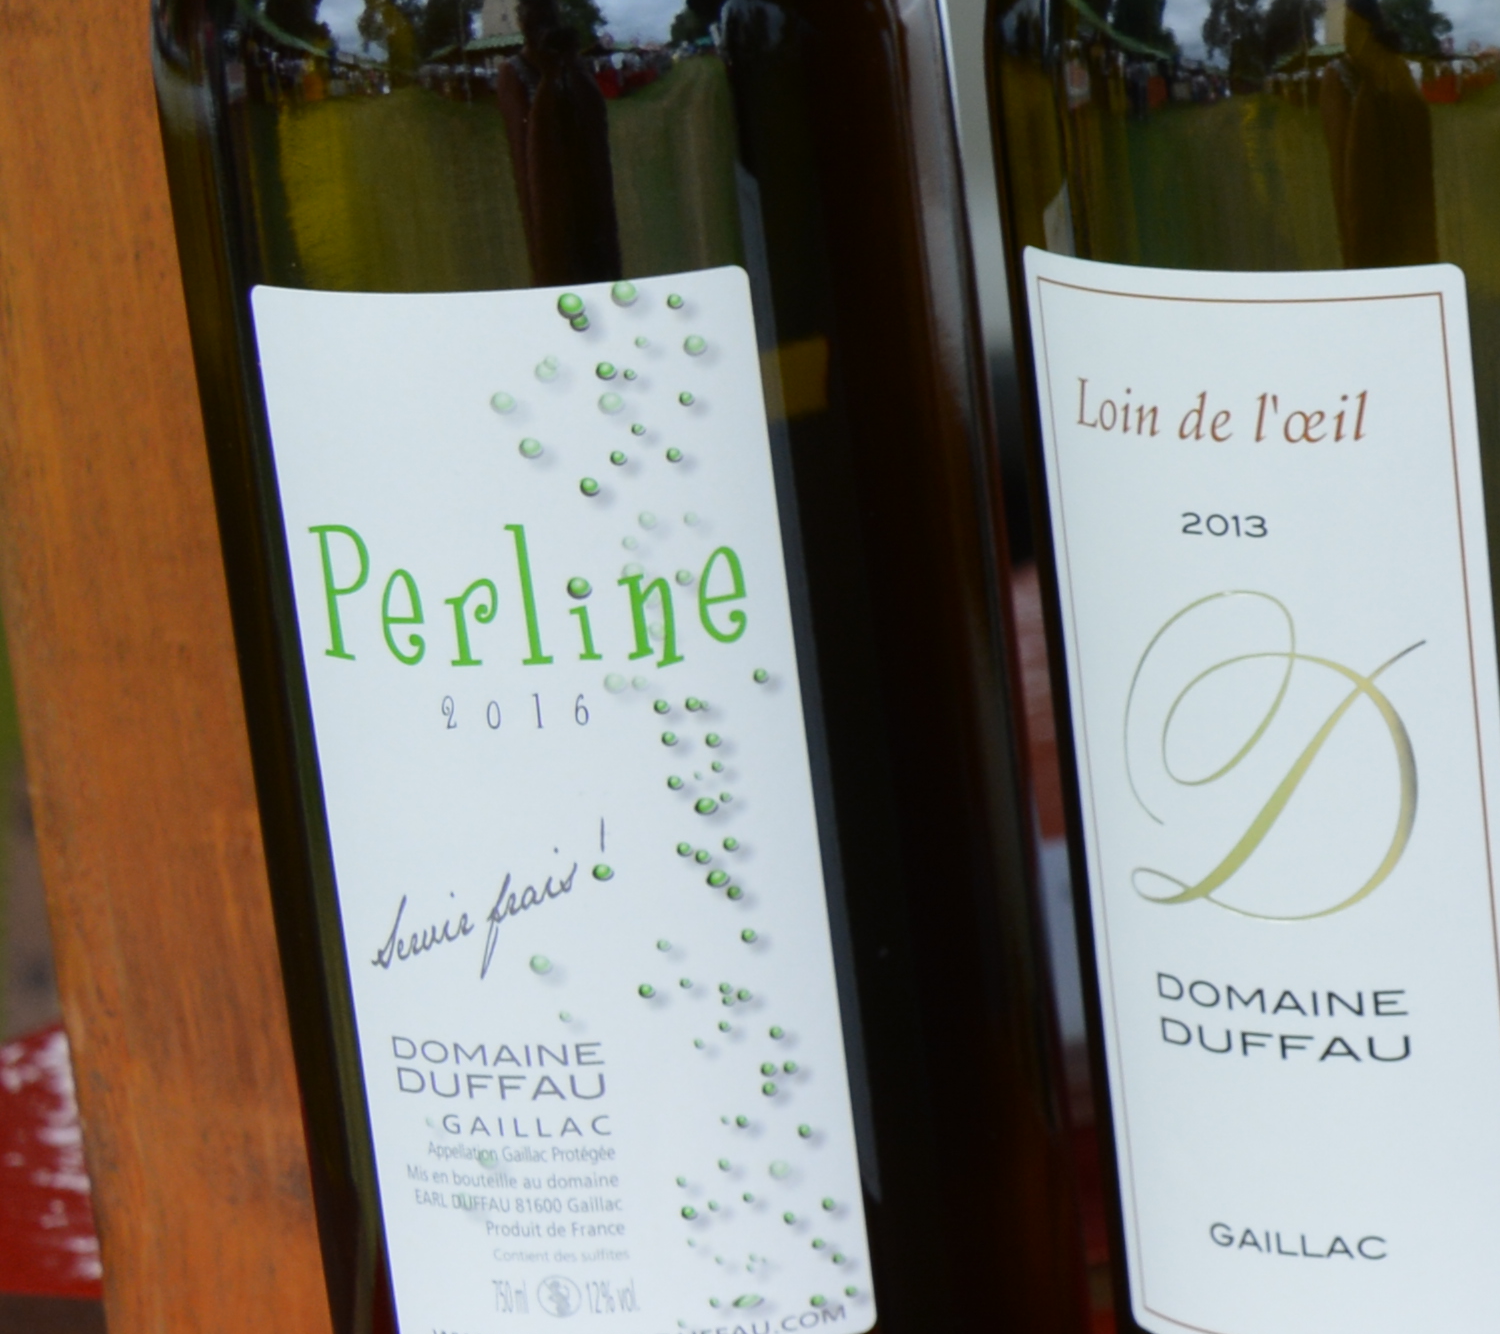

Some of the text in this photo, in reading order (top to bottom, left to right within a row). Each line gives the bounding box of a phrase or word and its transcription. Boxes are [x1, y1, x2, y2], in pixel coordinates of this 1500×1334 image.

[1076, 377, 1160, 437] Loin
[1177, 390, 1234, 443] de
[1181, 511, 1268, 538] 2013
[308, 524, 748, 669] Perline
[441, 693, 590, 730] 2016
[371, 890, 474, 970] Servir
[1156, 971, 1409, 1017] DOMAINE
[391, 1036, 605, 1067] DOMAINE
[1160, 1016, 1412, 1063] DUFFAU
[397, 1067, 606, 1101] DUFFAU
[442, 1114, 612, 1138] GAILLAC
[427, 1141, 616, 1166] Appellation Gaillac Protégée
[406, 1164, 619, 1190] Mis en bouteille au domaine
[415, 1189, 623, 1214] EARL DUFFAU 81600 Gaillac
[486, 1220, 626, 1238] Produit de France
[1209, 1222, 1388, 1260] GAILLAC
[493, 1248, 549, 1263] Contient
[553, 1249, 578, 1263] des
